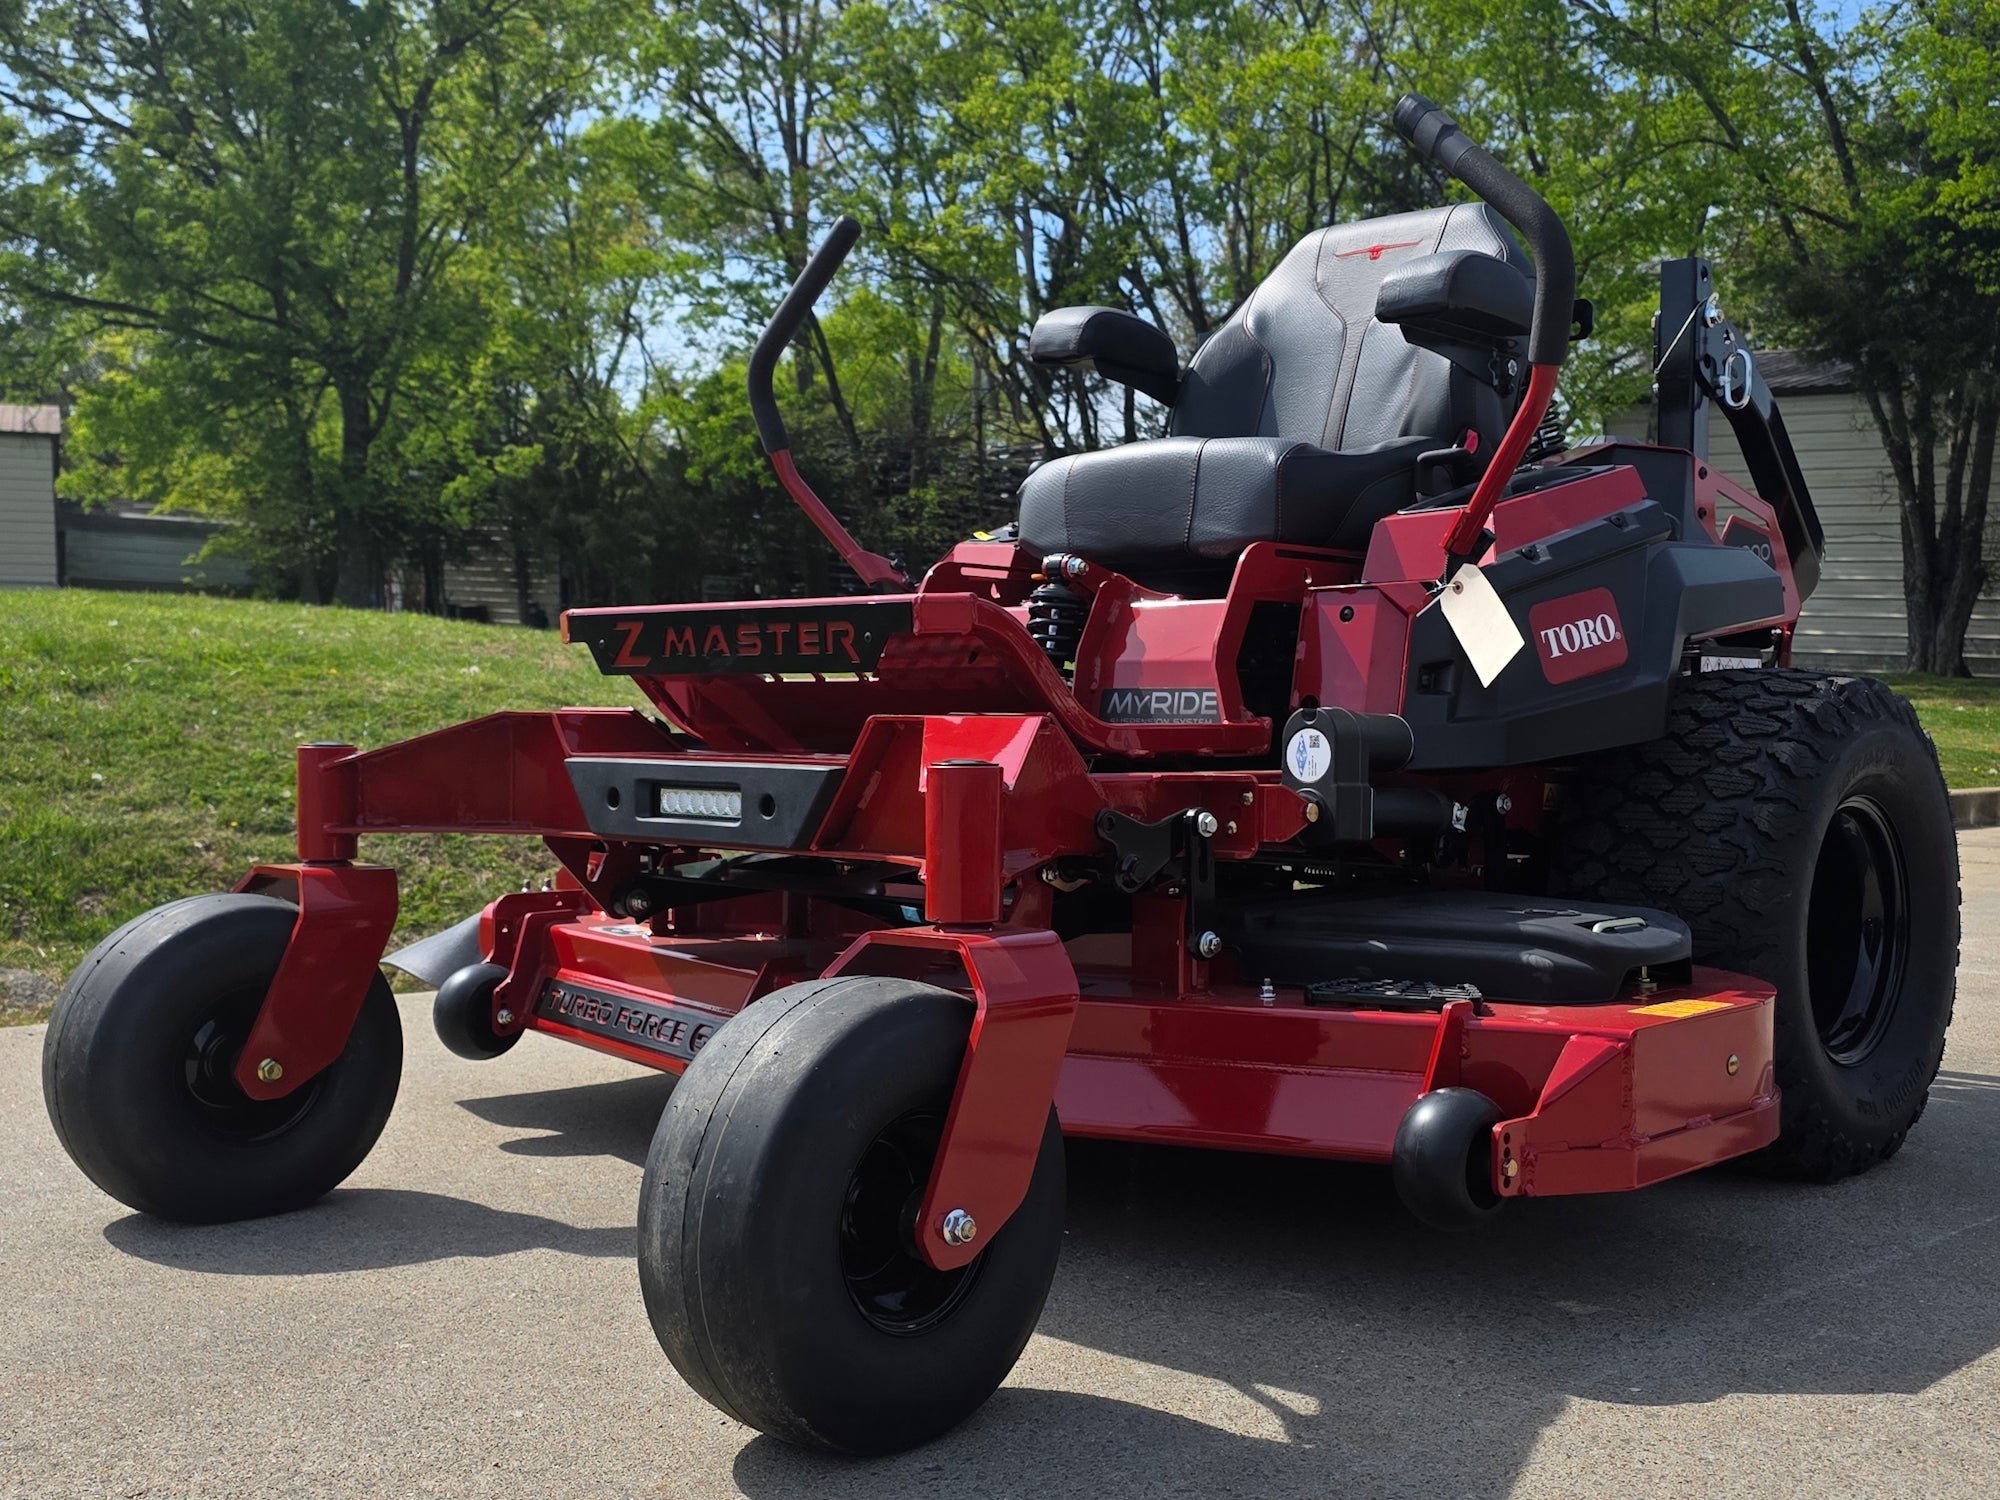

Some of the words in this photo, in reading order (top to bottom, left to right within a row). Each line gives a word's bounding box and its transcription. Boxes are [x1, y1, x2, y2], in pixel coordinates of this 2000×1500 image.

[611, 621, 652, 668] Z
[661, 620, 861, 664] MASTER
[548, 988, 615, 1025] TURBO
[612, 1004, 689, 1046] FORCE
